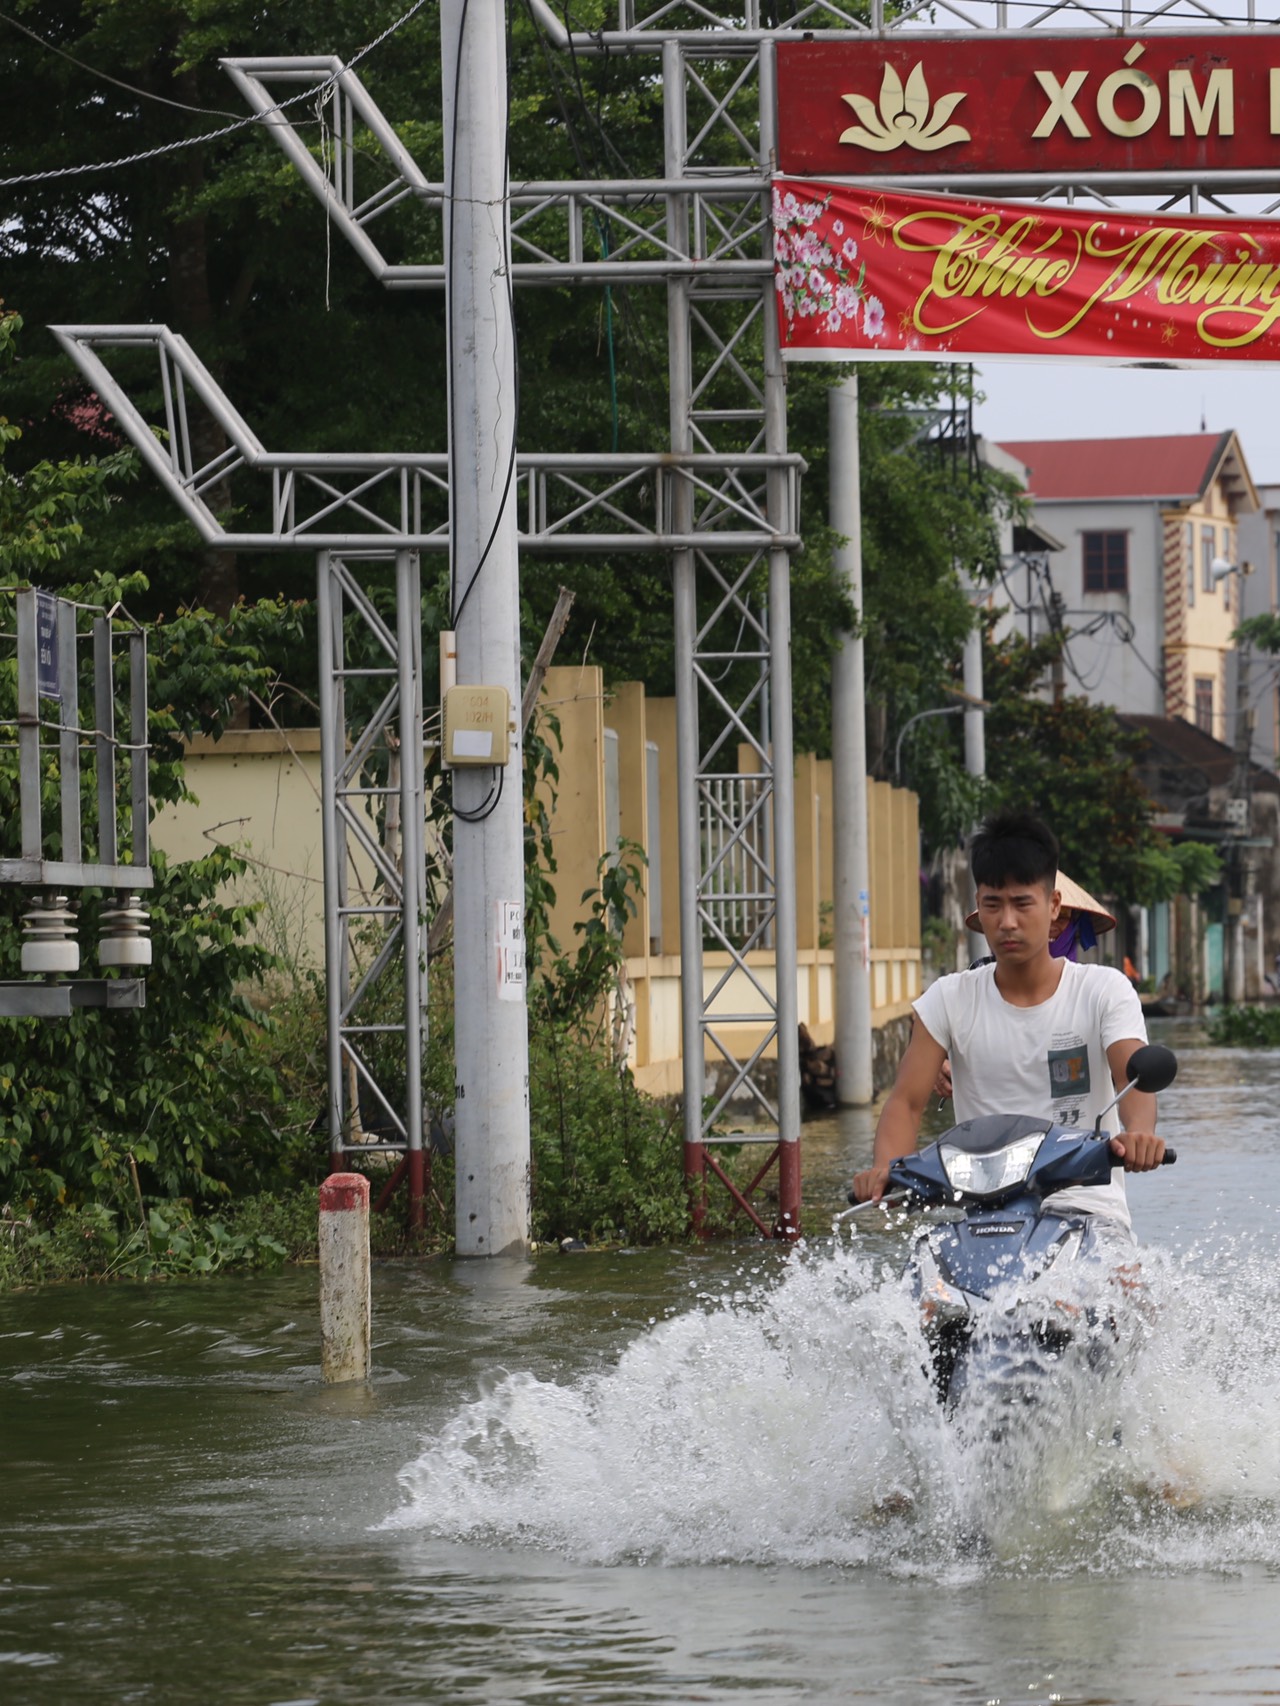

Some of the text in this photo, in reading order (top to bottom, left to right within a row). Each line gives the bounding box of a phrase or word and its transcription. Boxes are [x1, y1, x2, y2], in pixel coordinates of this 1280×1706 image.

[1031, 41, 1235, 138] XÓM
[892, 212, 1082, 336] Chúc
[975, 1225, 1016, 1235] HONDA
